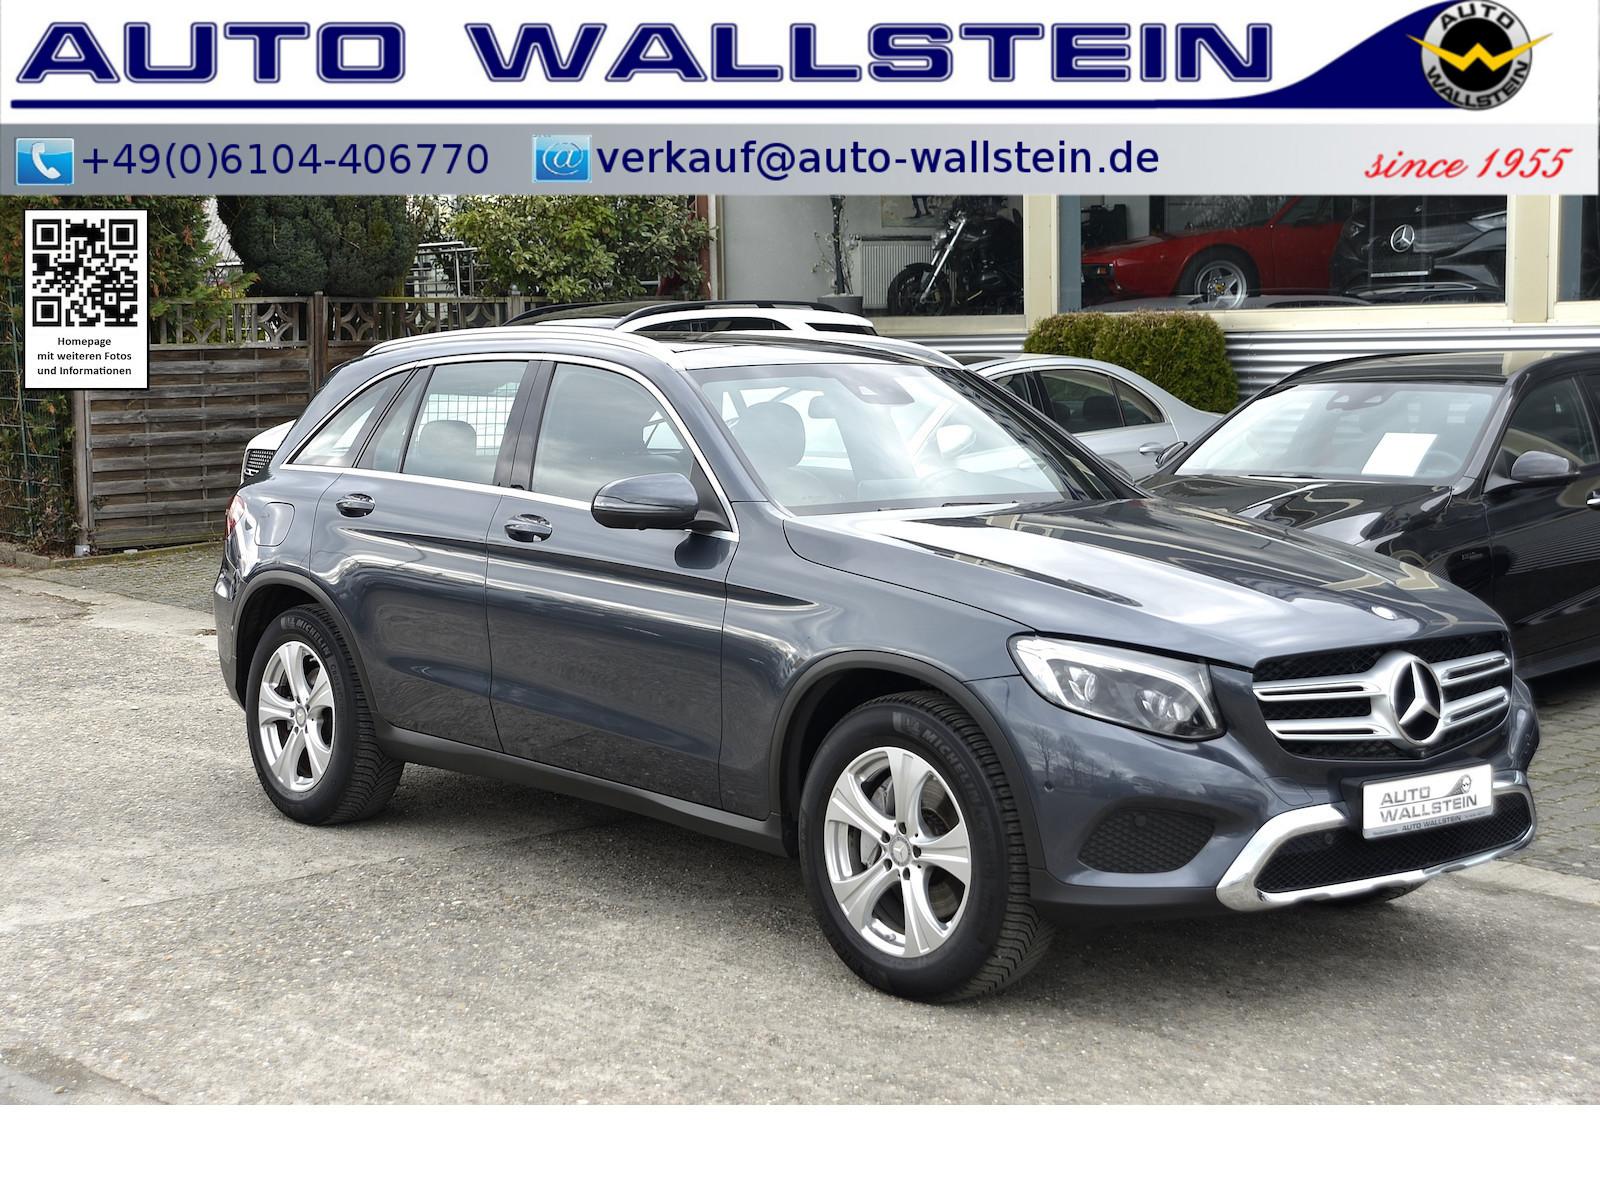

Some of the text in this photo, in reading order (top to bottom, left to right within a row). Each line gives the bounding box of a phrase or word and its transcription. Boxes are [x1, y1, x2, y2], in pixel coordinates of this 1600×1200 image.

[1380, 785, 1431, 806] AUTO
[1380, 794, 1478, 823] WALLSTEIN
[1402, 815, 1461, 831] AUTO WALLSTEIN
